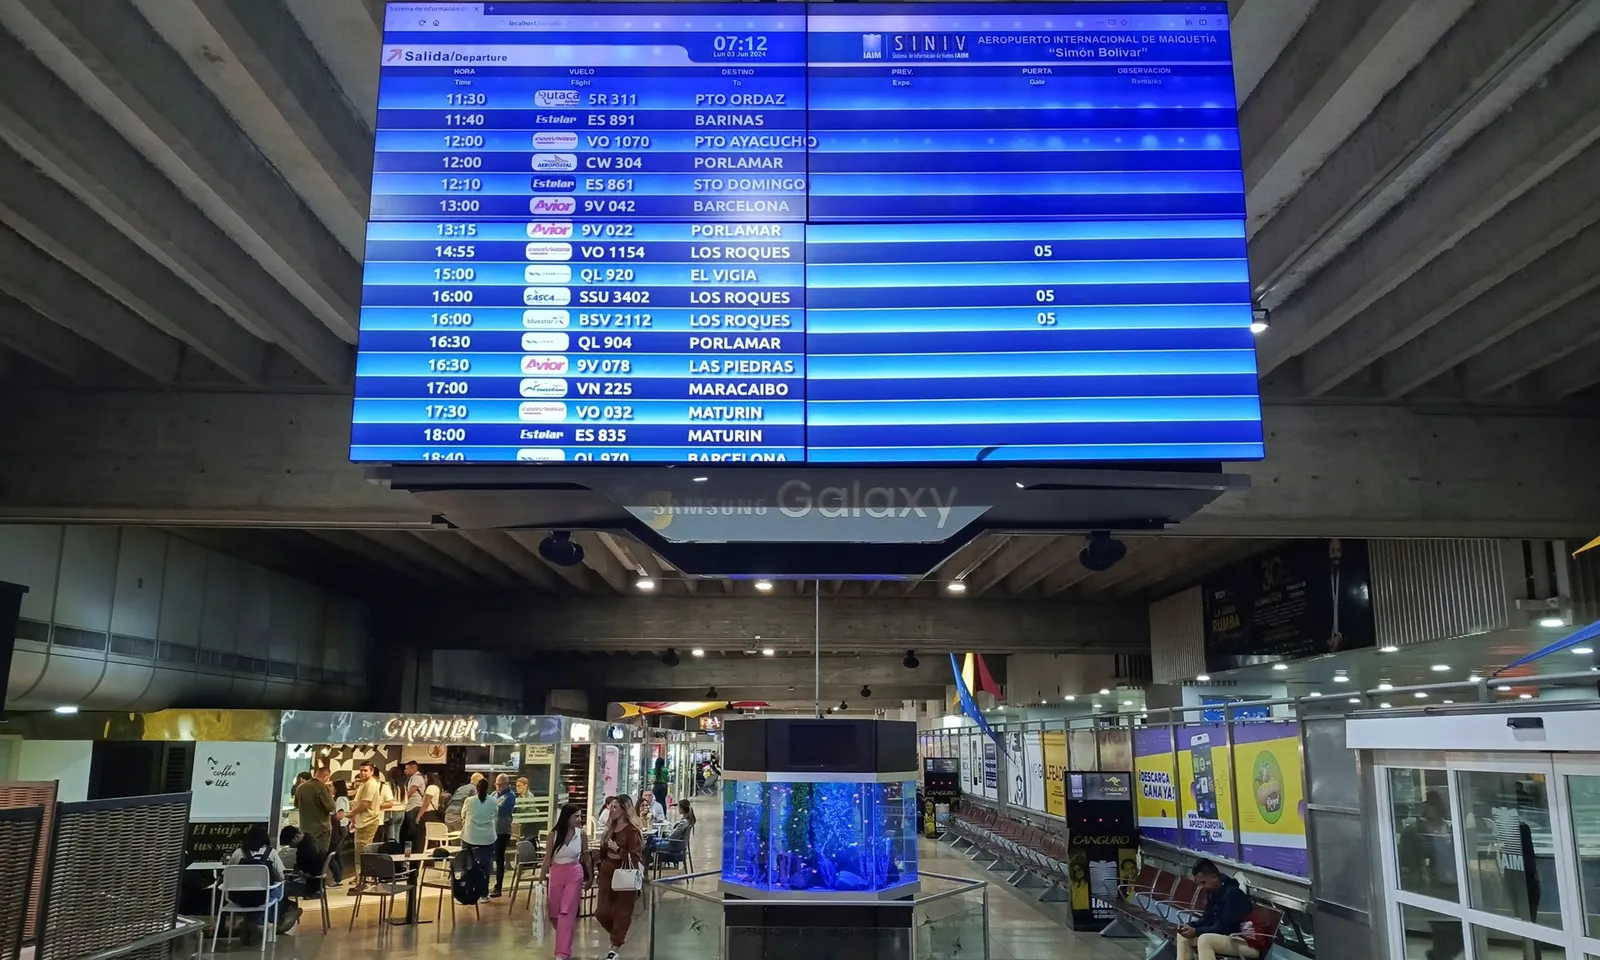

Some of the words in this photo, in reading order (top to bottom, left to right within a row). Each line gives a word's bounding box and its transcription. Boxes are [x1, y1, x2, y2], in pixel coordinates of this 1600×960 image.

[714, 36, 767, 53] 07:12
[978, 35, 1051, 45] AEROPUERTO
[1054, 35, 1135, 45] INTERNACIONAL
[1137, 35, 1156, 45] DE
[1158, 33, 1217, 44] MAIQUETÍA
[1022, 67, 1053, 75] PUERTA
[455, 79, 472, 87] Time
[571, 79, 591, 87] Flight
[892, 79, 912, 87] Expe.
[1029, 78, 1046, 86] Gate
[1131, 77, 1162, 85] Remarks
[447, 94, 485, 104] 11:30
[589, 94, 609, 106] 5R
[611, 94, 636, 106] 311
[696, 94, 729, 104] PTO
[731, 94, 784, 106] ORDAZ
[445, 115, 483, 125] 11:40
[535, 115, 577, 124] Estelar
[588, 115, 605, 125] ES
[610, 115, 634, 125] 891
[696, 115, 763, 125] BARINAS
[444, 136, 482, 146] 12:00
[587, 136, 612, 146] VO
[615, 136, 649, 147] 1070
[695, 136, 728, 148] PTO
[731, 136, 816, 148] AYACUCHO
[443, 157, 481, 167] 12:00
[587, 157, 611, 168] CW
[615, 157, 642, 168] 304
[695, 157, 783, 168] PORLAMAR
[442, 178, 480, 189] 12:10
[533, 179, 574, 188] Estelar
[586, 179, 603, 190] ES
[607, 179, 632, 190] 861
[694, 179, 723, 191] STO
[727, 179, 805, 191] DOMINGO
[440, 200, 479, 211] 13:00
[534, 199, 574, 212] Avior
[585, 201, 605, 211] 9V
[609, 201, 635, 211] 042
[695, 199, 789, 211] BARCELONA
[437, 224, 475, 235] 13:15
[531, 223, 571, 235] Avior
[582, 224, 602, 235] 9V
[606, 224, 632, 235] 022
[692, 224, 781, 236] PORLAMAR
[436, 246, 474, 257] 14:55
[581, 247, 604, 257] VO
[610, 247, 644, 258] 1154
[692, 247, 721, 258] LOS
[726, 247, 790, 260] ROQUES
[1035, 245, 1052, 256] 05
[434, 268, 473, 279] 15:00
[581, 269, 602, 282] QL
[606, 269, 633, 280] 920
[691, 270, 709, 280] EL
[713, 269, 756, 281] VIGIA
[433, 291, 472, 302] 16:00
[580, 291, 608, 302] SSU
[613, 291, 649, 303] 3402
[691, 292, 720, 303] LOS
[725, 292, 790, 306] ROQUES
[1036, 290, 1054, 301] 05
[432, 313, 471, 324] 16:00
[580, 314, 611, 325] BSV
[615, 314, 651, 326] 2112
[690, 315, 720, 326] LOS
[725, 315, 790, 328] ROQUES
[1038, 313, 1055, 324] 05
[430, 336, 470, 347] 16:30
[579, 336, 600, 350] QL
[604, 337, 632, 348] 904
[690, 337, 780, 349] PORLAMAR
[429, 359, 469, 370] 16:30
[525, 358, 566, 371] Avior
[577, 360, 598, 372] 9V
[602, 360, 629, 371] 078
[689, 360, 720, 372] LAS
[724, 361, 793, 372] PIEDRAS
[427, 382, 468, 394] 17:00
[577, 383, 600, 394] VN
[605, 383, 631, 395] 225
[689, 383, 788, 395] MARACAIBO
[426, 405, 466, 417] 17:30
[576, 406, 599, 418] VO
[602, 406, 631, 418] 032
[688, 407, 761, 419] MATURIN
[424, 429, 465, 440] 18:00
[519, 430, 564, 439] Estelar
[576, 429, 594, 441] ES
[598, 429, 626, 441] 835
[689, 430, 761, 442] MATURIN
[652, 497, 768, 516] SAMSUNG
[777, 480, 958, 528] Galaxy
[1212, 614, 1241, 634] RUMBA
[384, 718, 479, 742] GRANIER
[212, 764, 237, 777] coffee
[215, 779, 230, 787] life
[1143, 784, 1163, 798] GANA
[1163, 786, 1175, 800] YA!
[1189, 820, 1225, 830] APUESTASROYAL
[192, 824, 206, 835] El
[209, 824, 241, 838] viaje
[1073, 835, 1130, 845] CANGURO
[193, 841, 213, 851] tus
